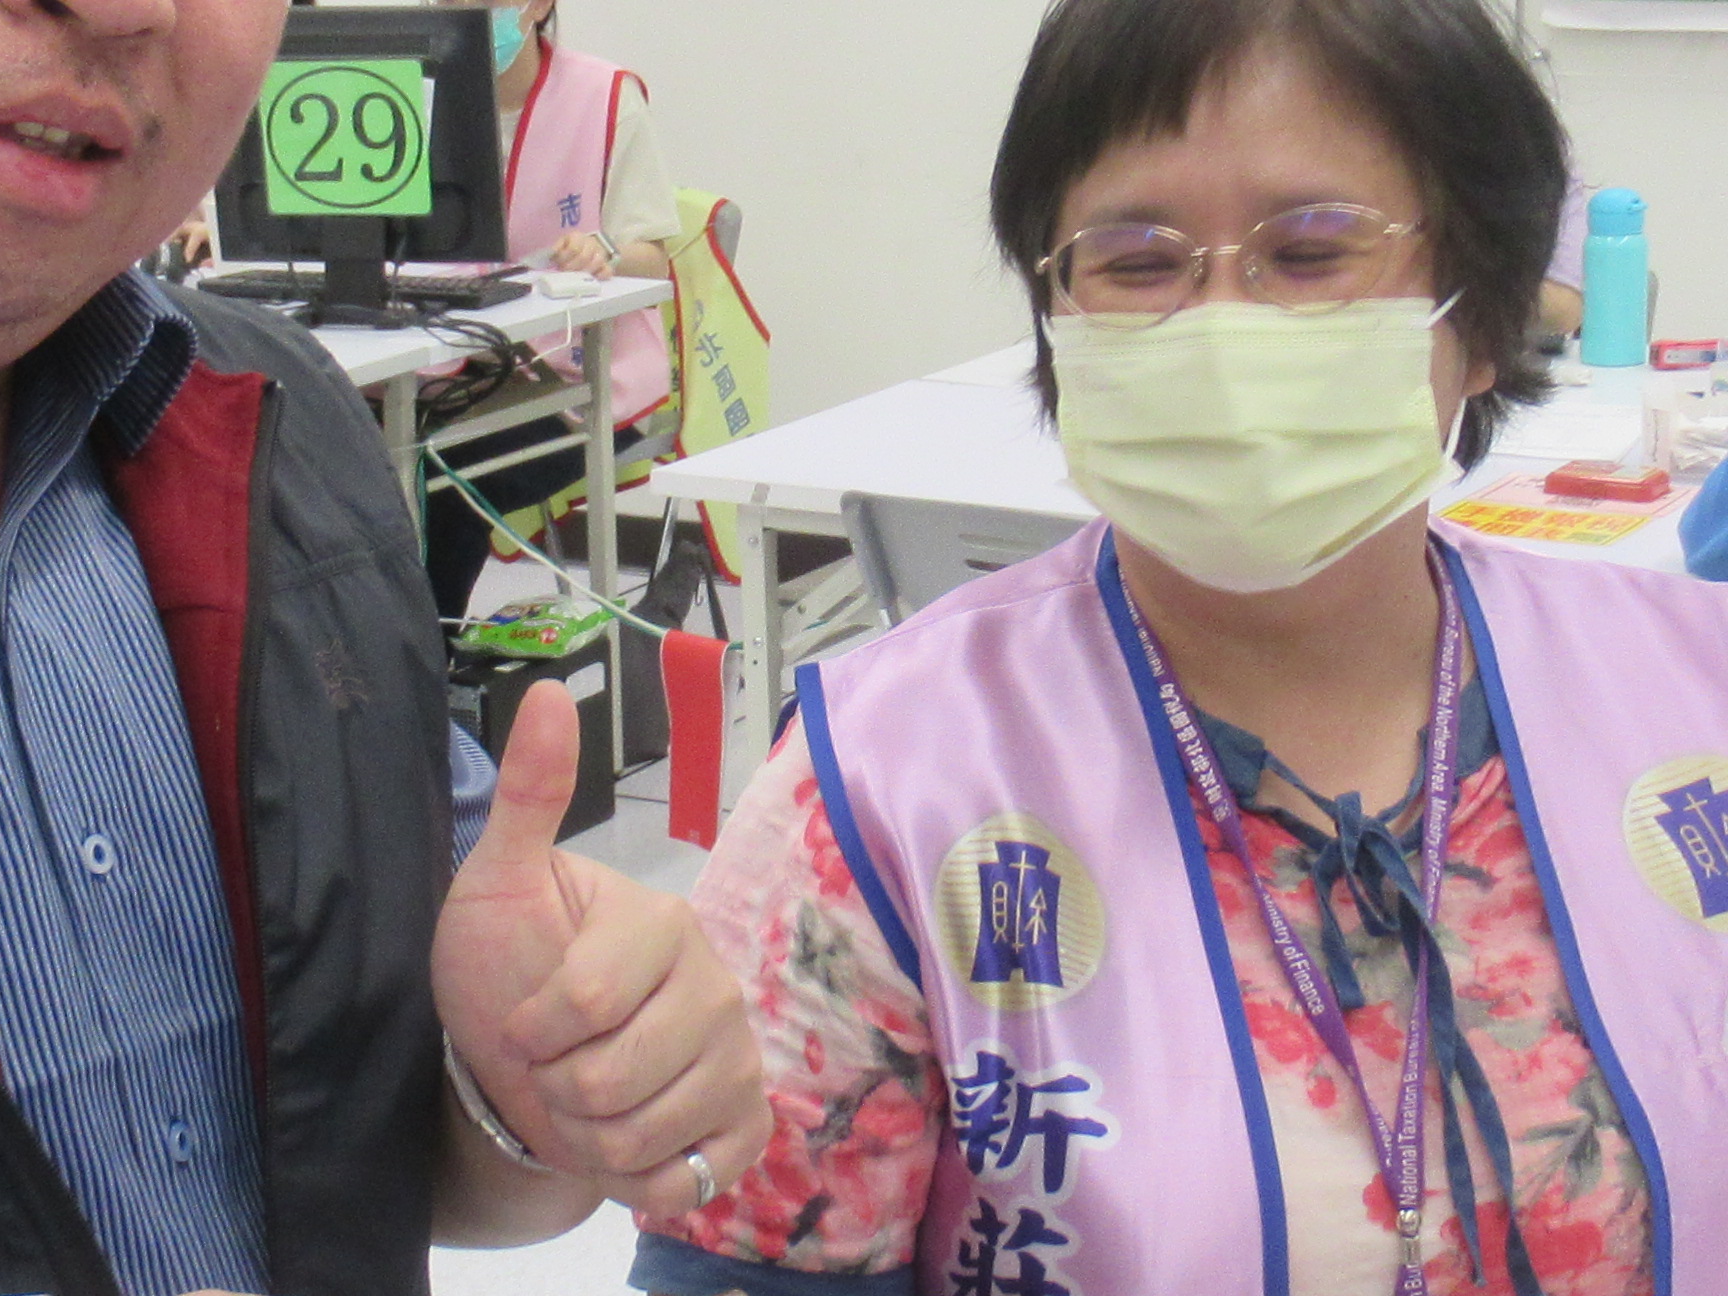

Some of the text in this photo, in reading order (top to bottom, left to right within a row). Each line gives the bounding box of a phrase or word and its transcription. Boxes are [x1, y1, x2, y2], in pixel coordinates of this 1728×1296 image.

[289, 92, 407, 183] 29
[1159, 682, 1223, 804] 財政部北區國稅局
[1426, 800, 1448, 847] Ministry
[1291, 958, 1325, 1017] Finance
[1402, 1085, 1419, 1139] Taxation
[1399, 1138, 1417, 1205] National
